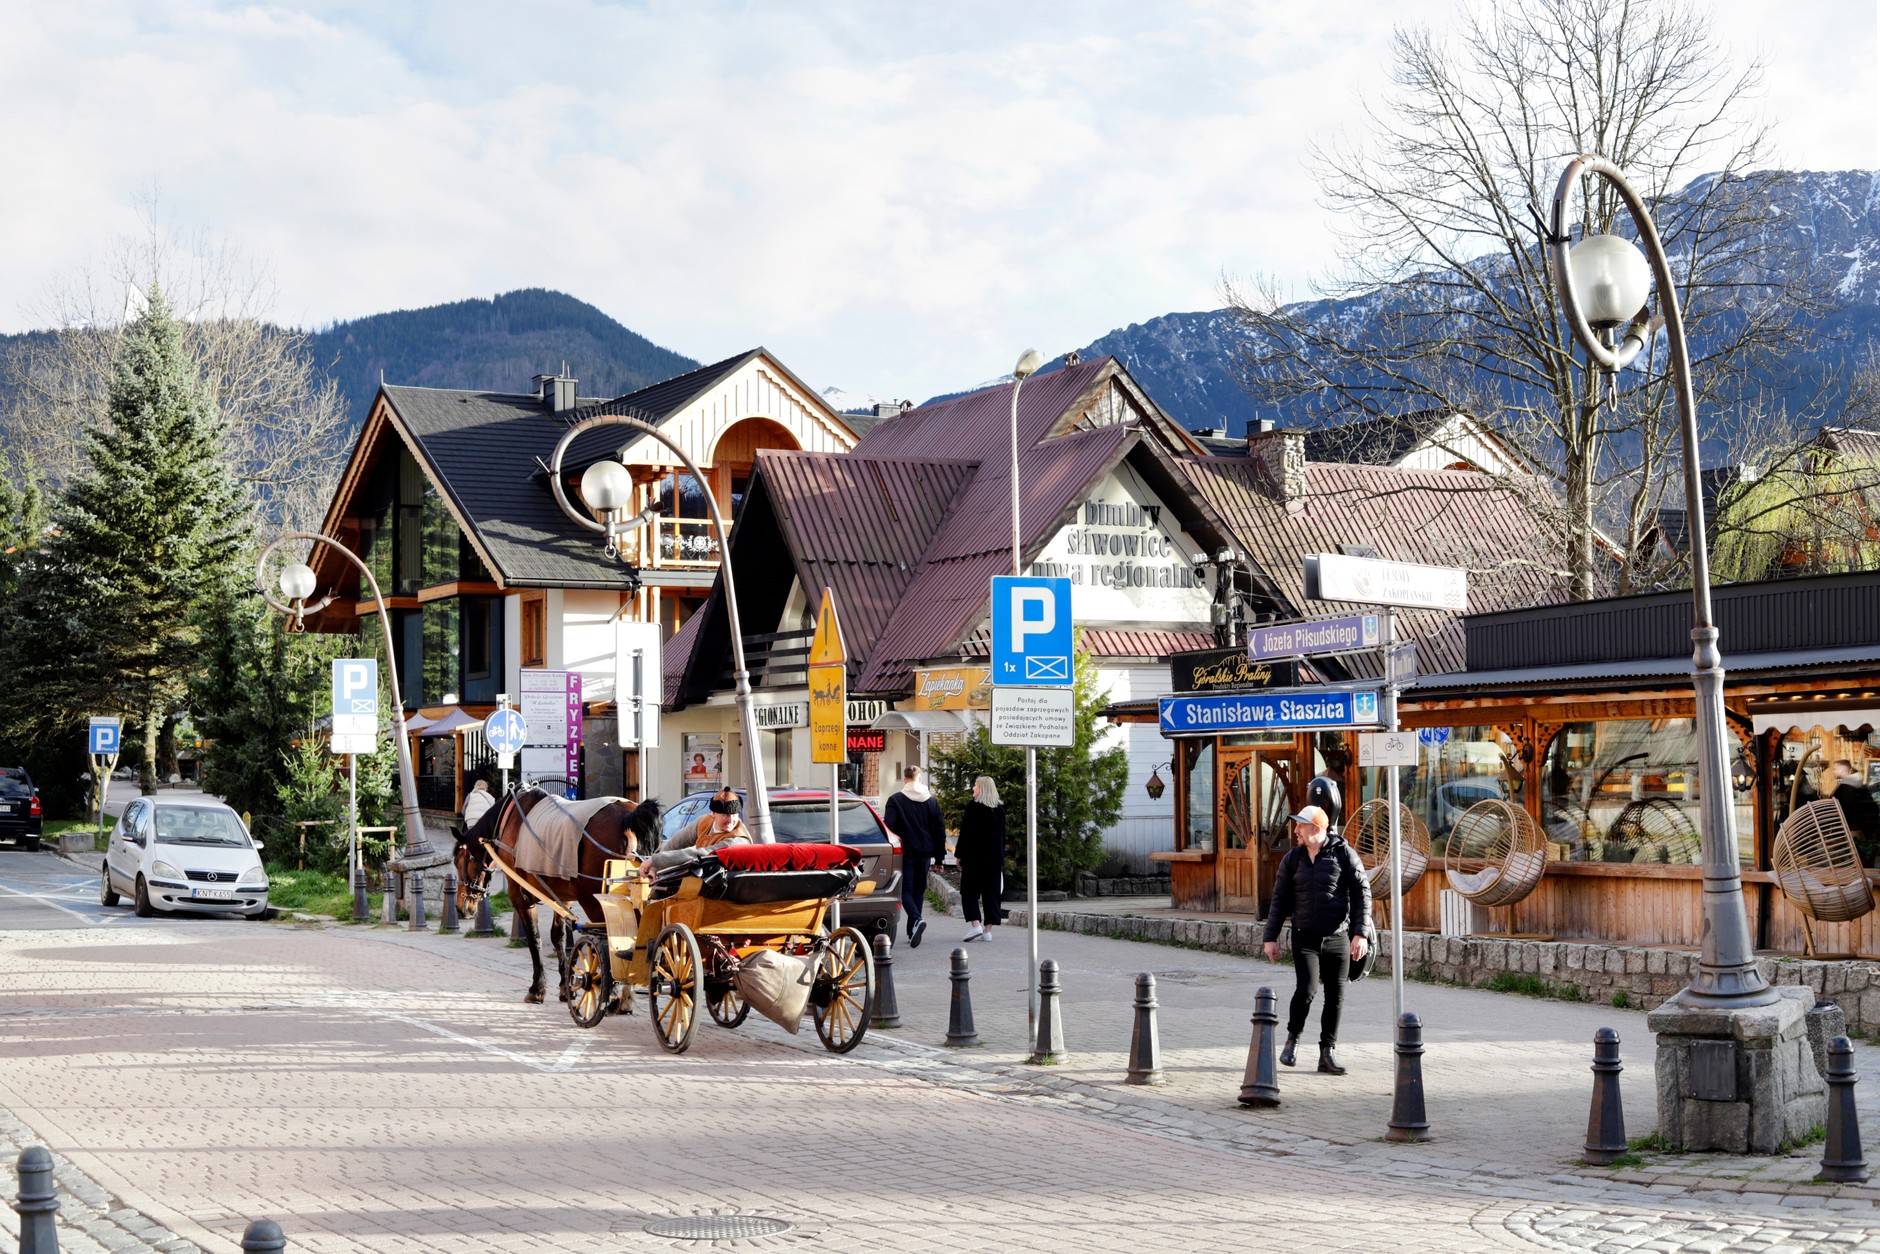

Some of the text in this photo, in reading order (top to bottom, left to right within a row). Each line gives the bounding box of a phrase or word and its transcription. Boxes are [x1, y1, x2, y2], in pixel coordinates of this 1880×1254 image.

[1085, 499, 1161, 530] bimbry
[1091, 561, 1206, 590] regionalne
[1011, 587, 1055, 653] P
[1263, 624, 1358, 653] Józefa Piłsudskiego
[1004, 661, 1016, 673] 1x
[1192, 663, 1272, 690] Góralskie Praliny
[343, 664, 368, 700] P
[1186, 699, 1345, 725] Stanisława Staszica
[96, 728, 114, 751] P
[819, 740, 838, 751] konne
[1030, 731, 1061, 739] Zakopane
